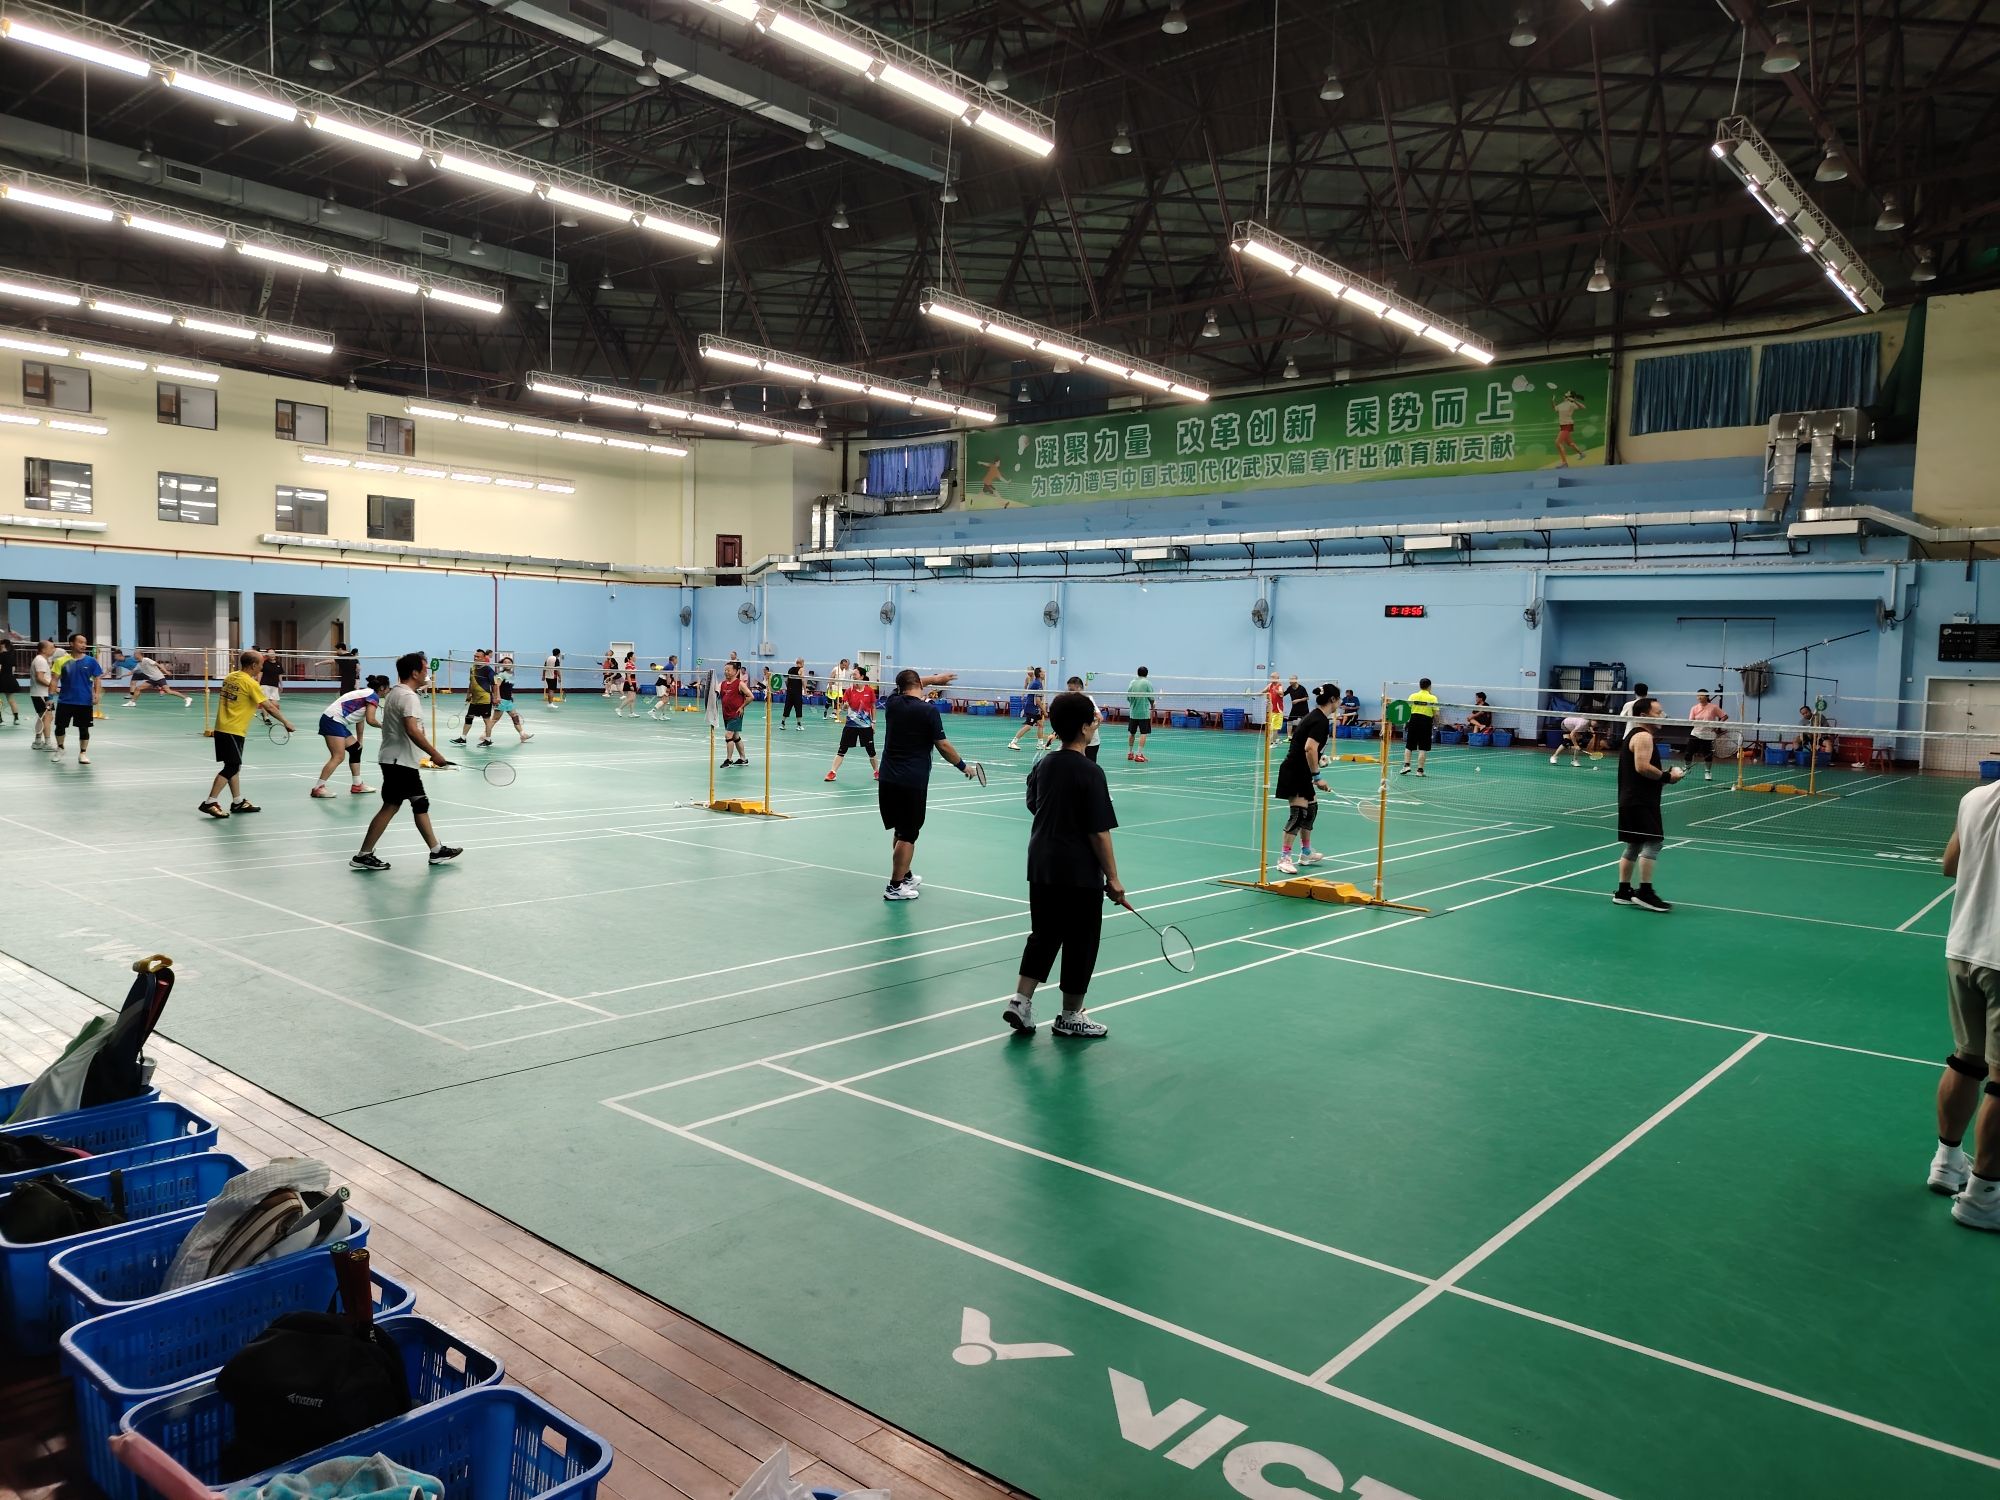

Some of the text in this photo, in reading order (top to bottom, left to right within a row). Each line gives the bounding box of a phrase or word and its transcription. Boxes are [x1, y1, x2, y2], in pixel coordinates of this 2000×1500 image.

[1035, 382, 1514, 468] 凝聚力量 改革创新 乘势而上
[1032, 432, 1515, 498] 为奋力谱写中国式现代化武汉篇章作出体育新贡献
[431, 660, 438, 670] 3
[773, 674, 780, 689] 2
[1394, 704, 1404, 721] 1
